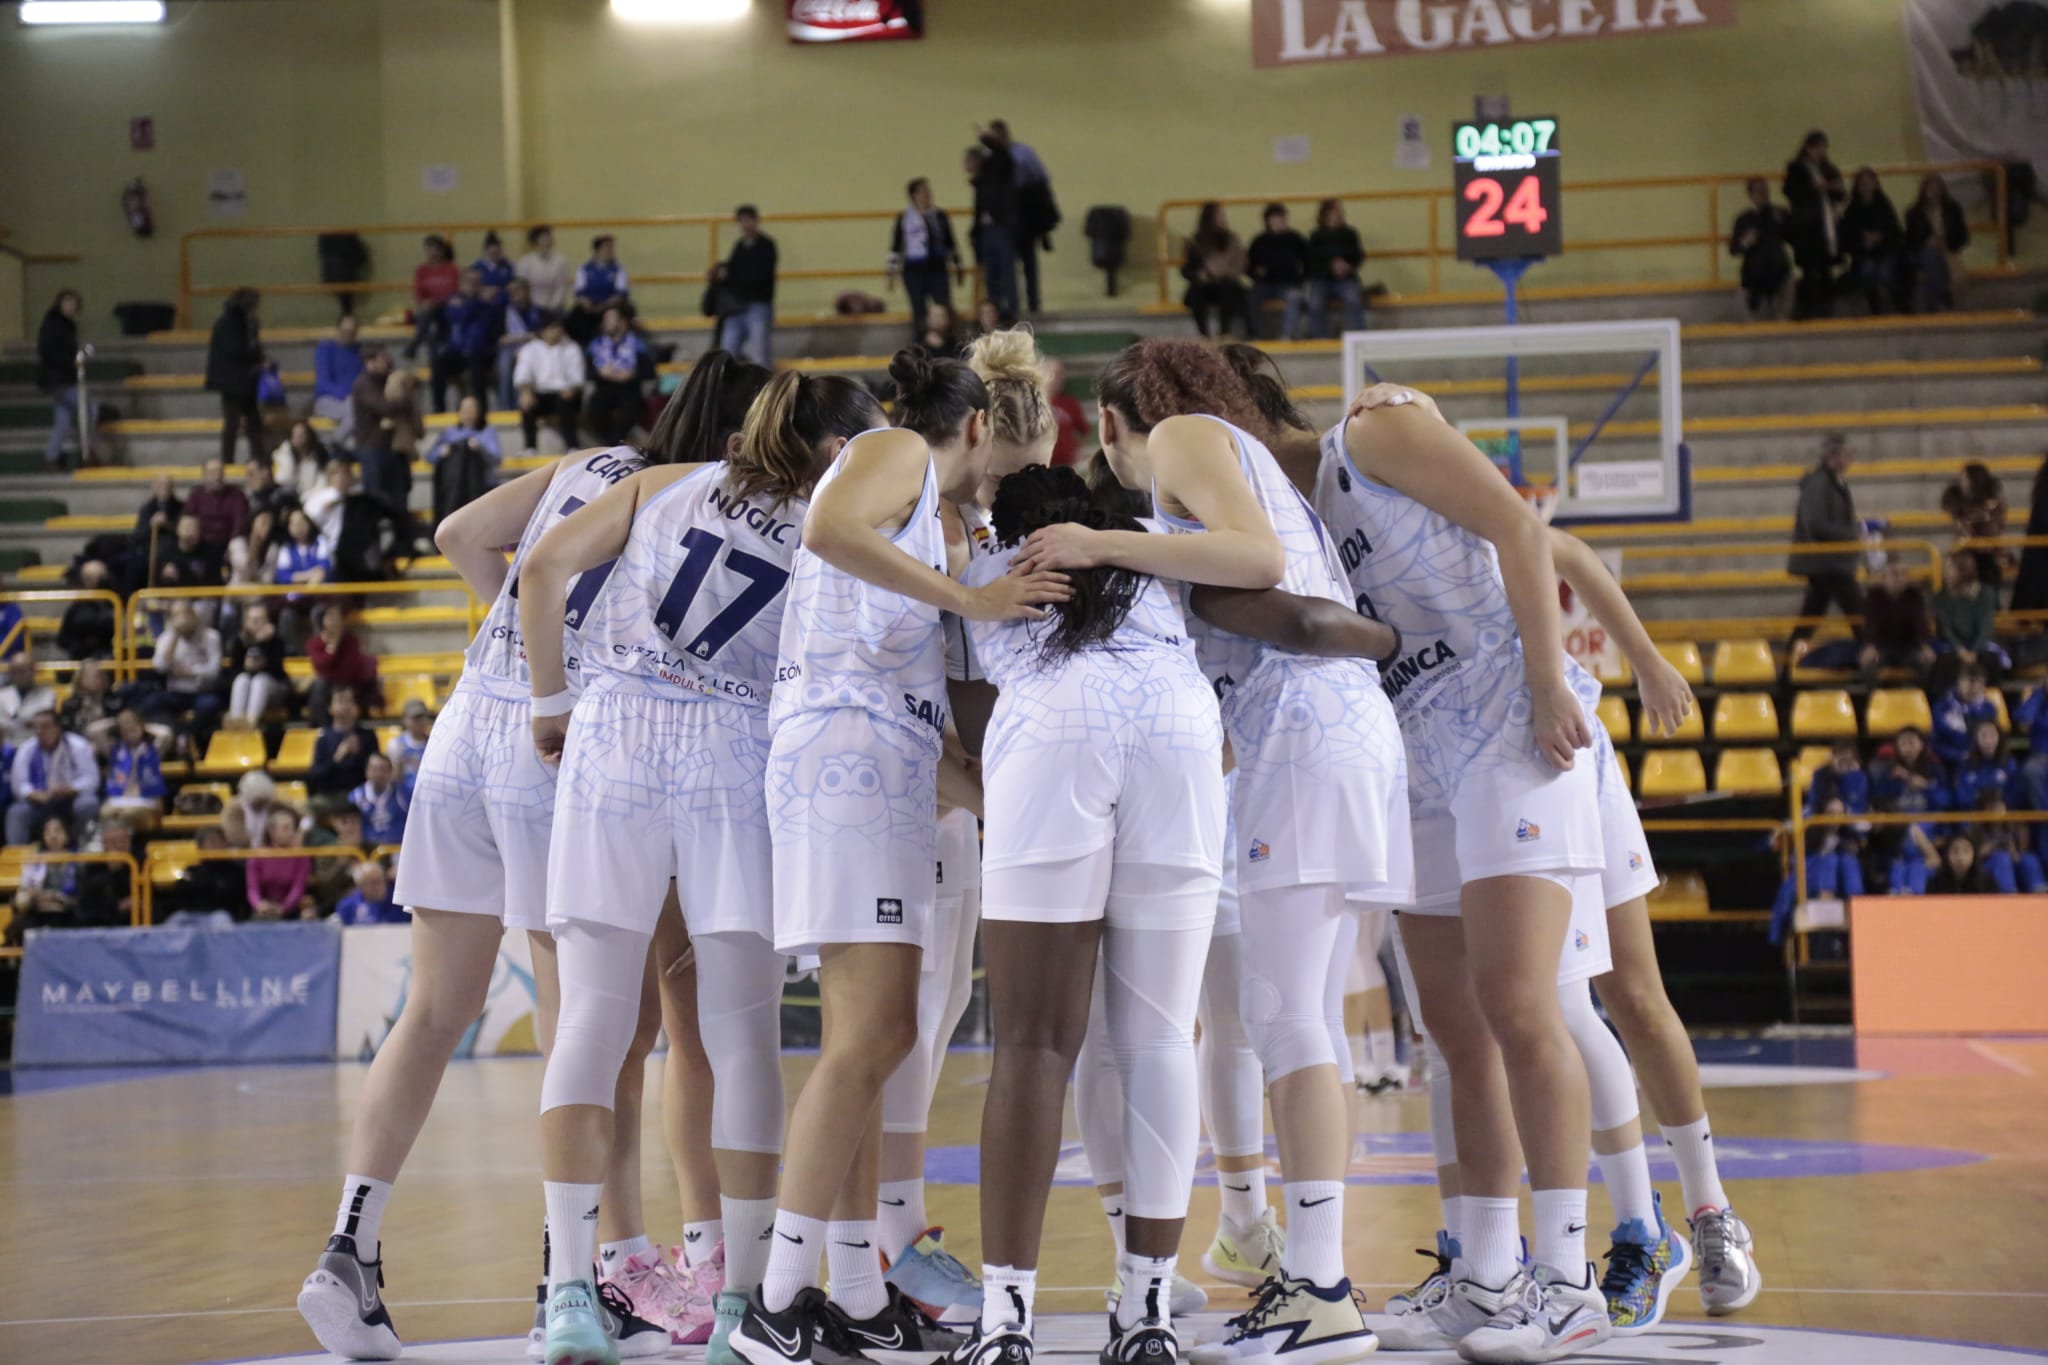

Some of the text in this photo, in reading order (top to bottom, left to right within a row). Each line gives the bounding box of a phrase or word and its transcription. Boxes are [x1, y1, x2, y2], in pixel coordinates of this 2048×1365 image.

[1279, 0, 1386, 61] LA
[1455, 119, 1556, 159] 04:07
[1463, 175, 1548, 238] 24
[585, 453, 642, 485] CAR
[653, 526, 791, 662] 17
[42, 973, 310, 1007] MAYBELLINE
